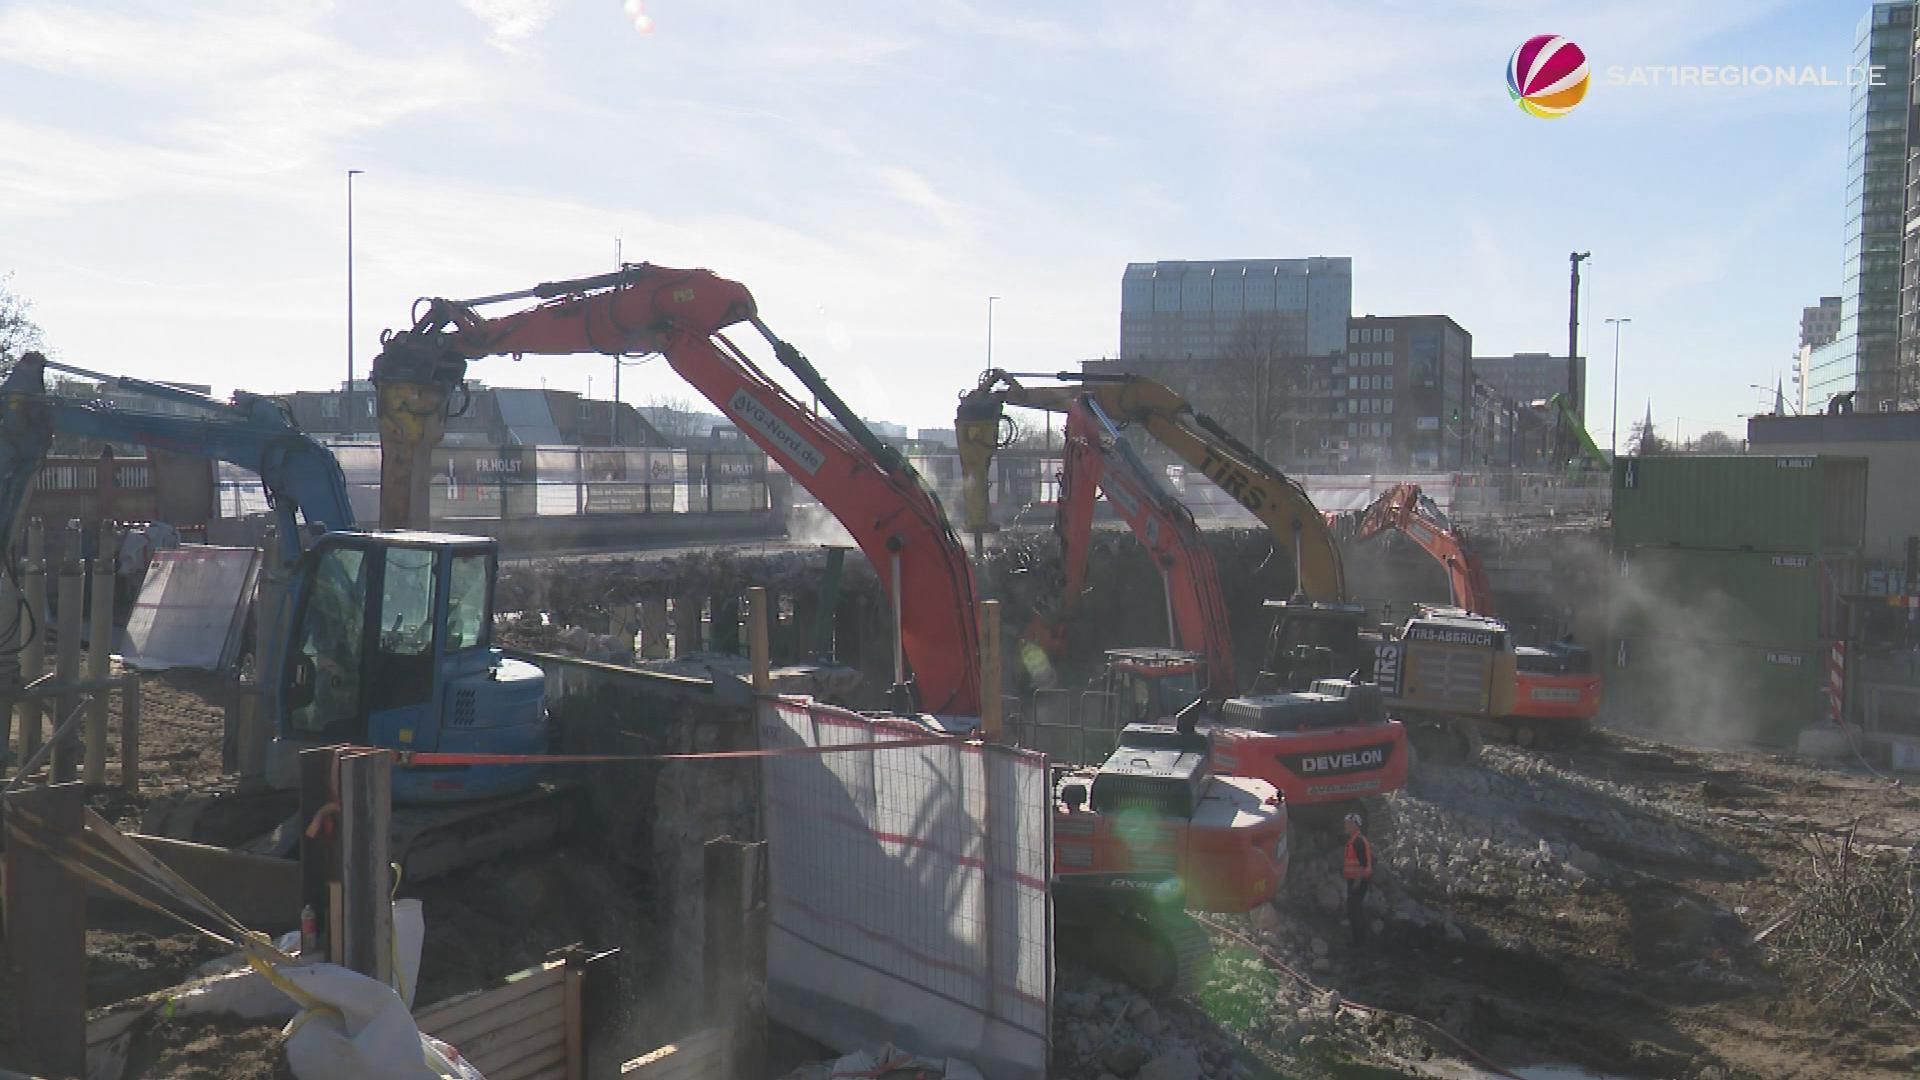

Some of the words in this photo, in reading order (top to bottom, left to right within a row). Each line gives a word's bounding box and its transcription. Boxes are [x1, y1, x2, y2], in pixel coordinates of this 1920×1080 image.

[476, 458, 522, 474] FR.HOLST
[1409, 628, 1493, 647] TIRS-ABBRUCH
[1301, 749, 1383, 773] DEVELON
